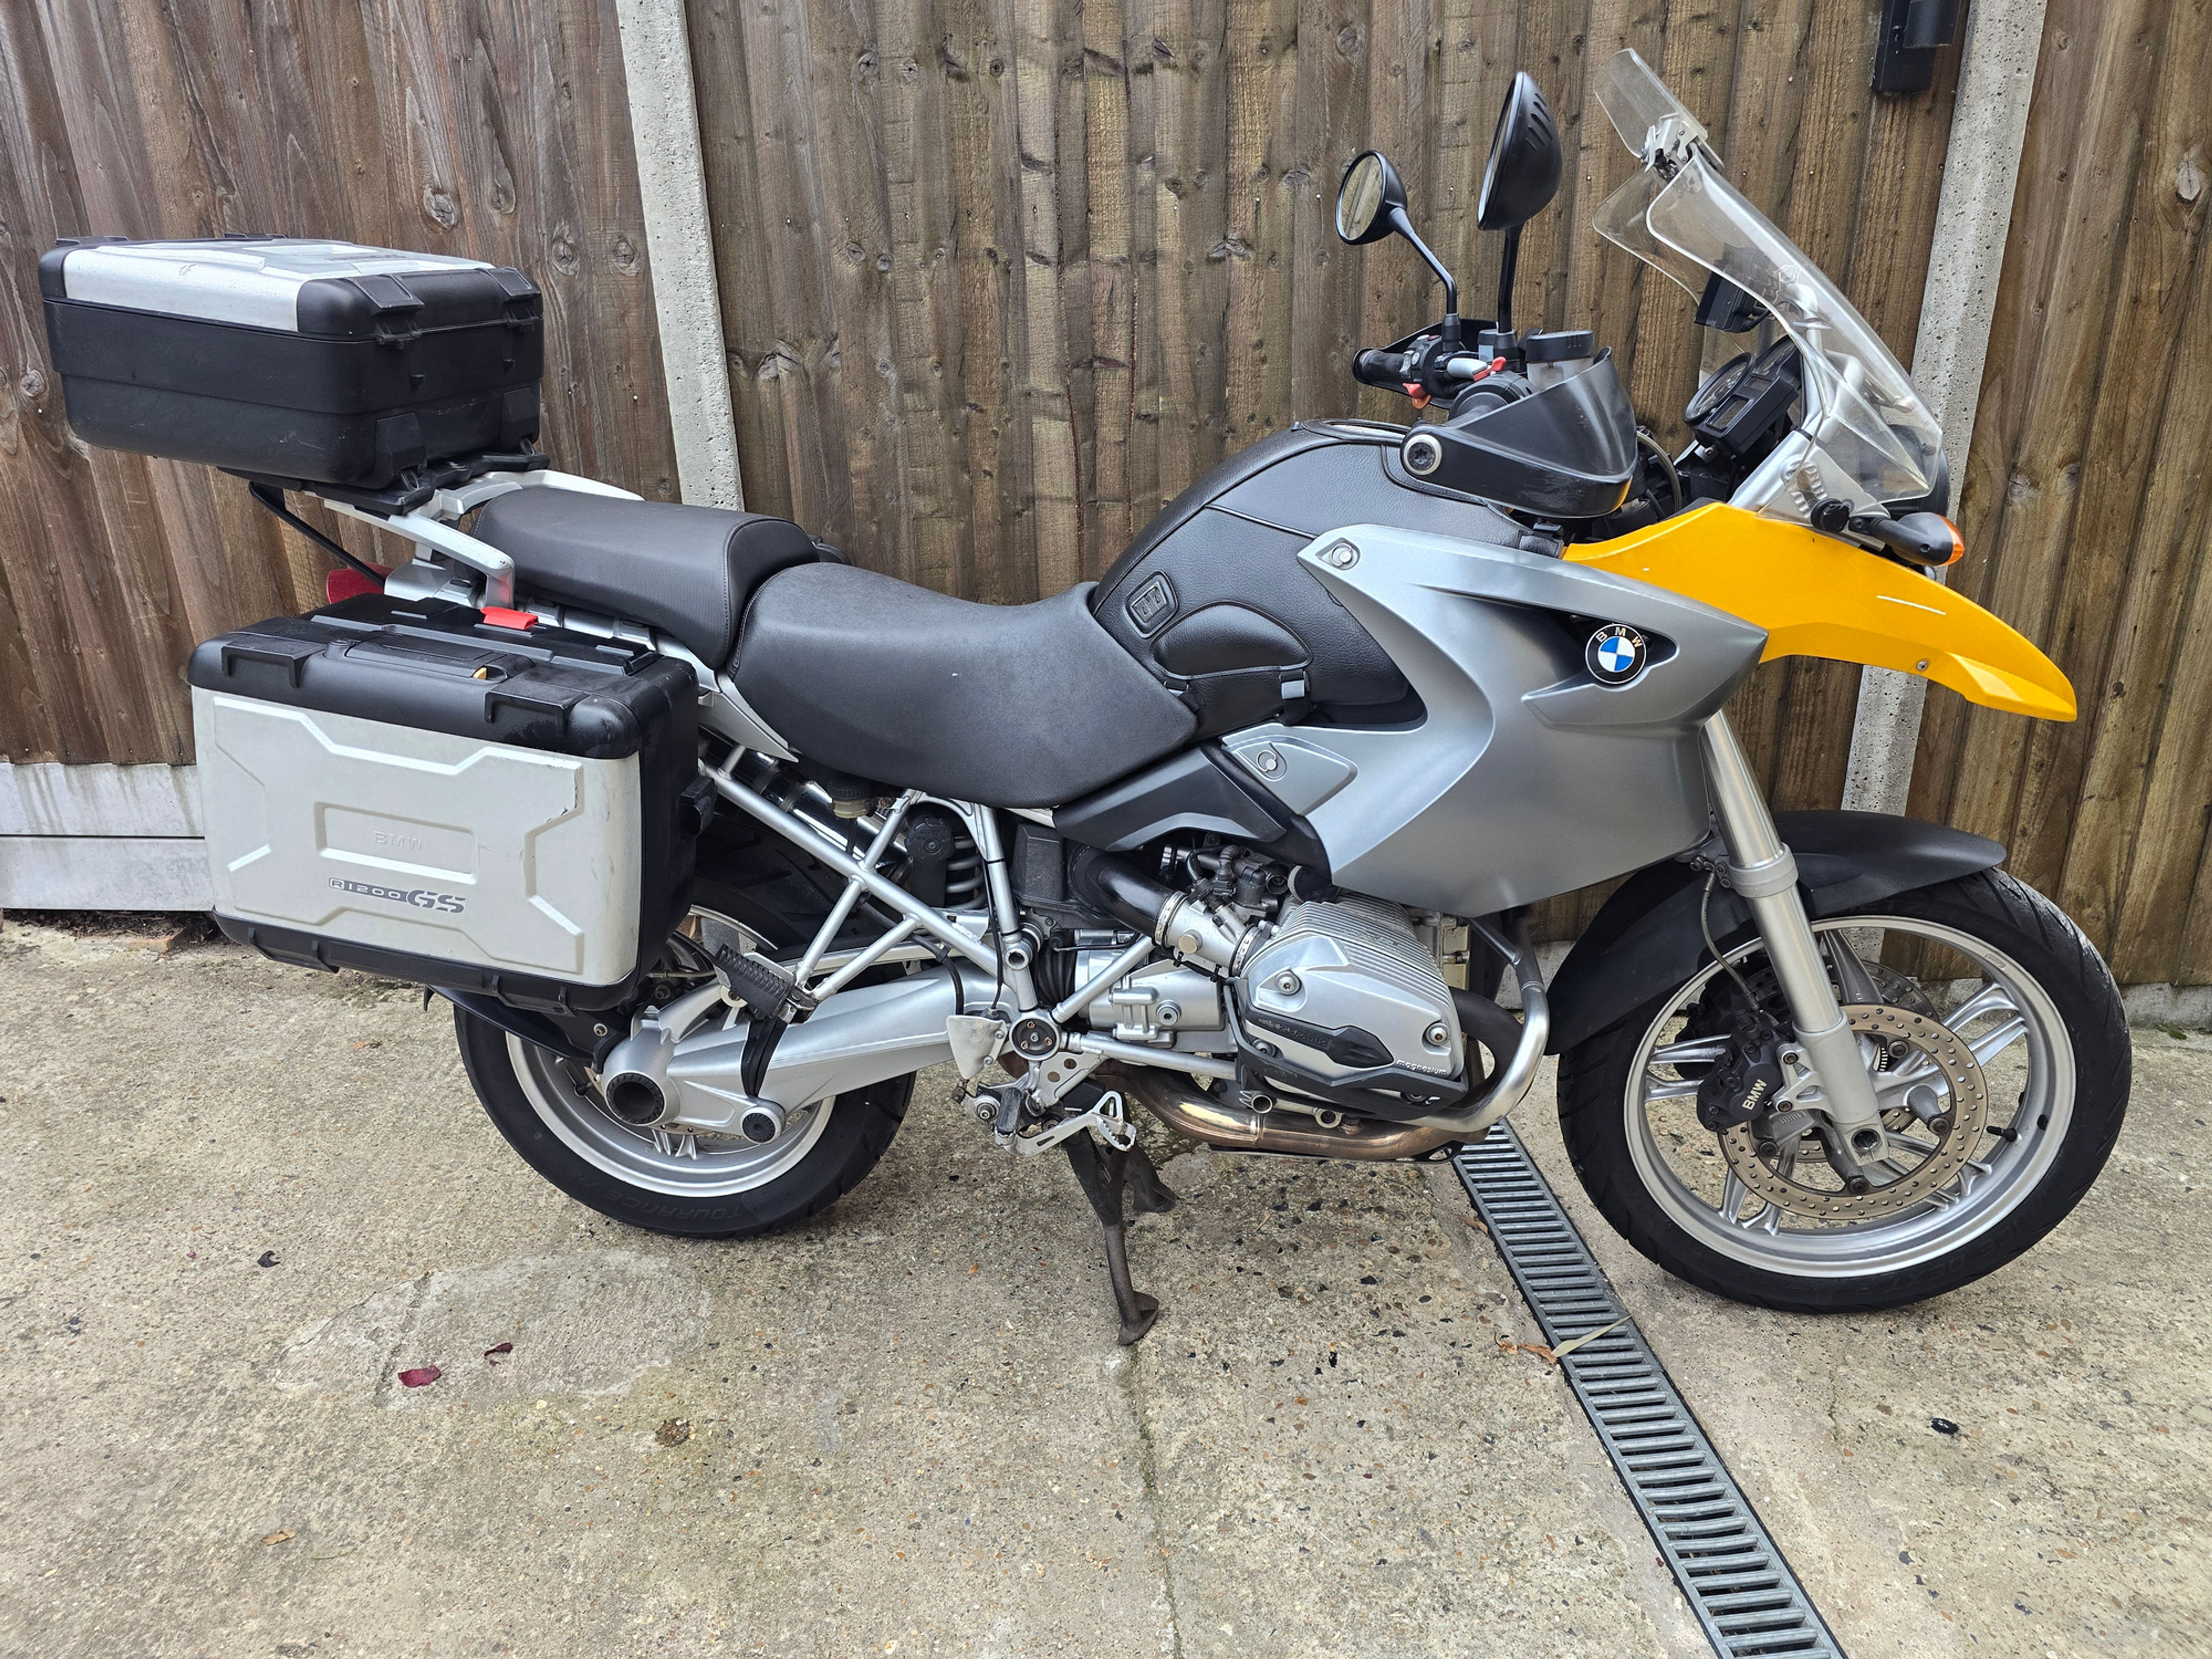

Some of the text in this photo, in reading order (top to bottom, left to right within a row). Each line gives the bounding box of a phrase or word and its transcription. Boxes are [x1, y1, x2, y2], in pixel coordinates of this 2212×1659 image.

[1595, 627, 1642, 648] BMW
[374, 831, 424, 851] BMW
[1396, 1060, 1447, 1075] magnesium
[1742, 1079, 1767, 1110] BMW
[602, 1190, 744, 1220] TOURANCE
